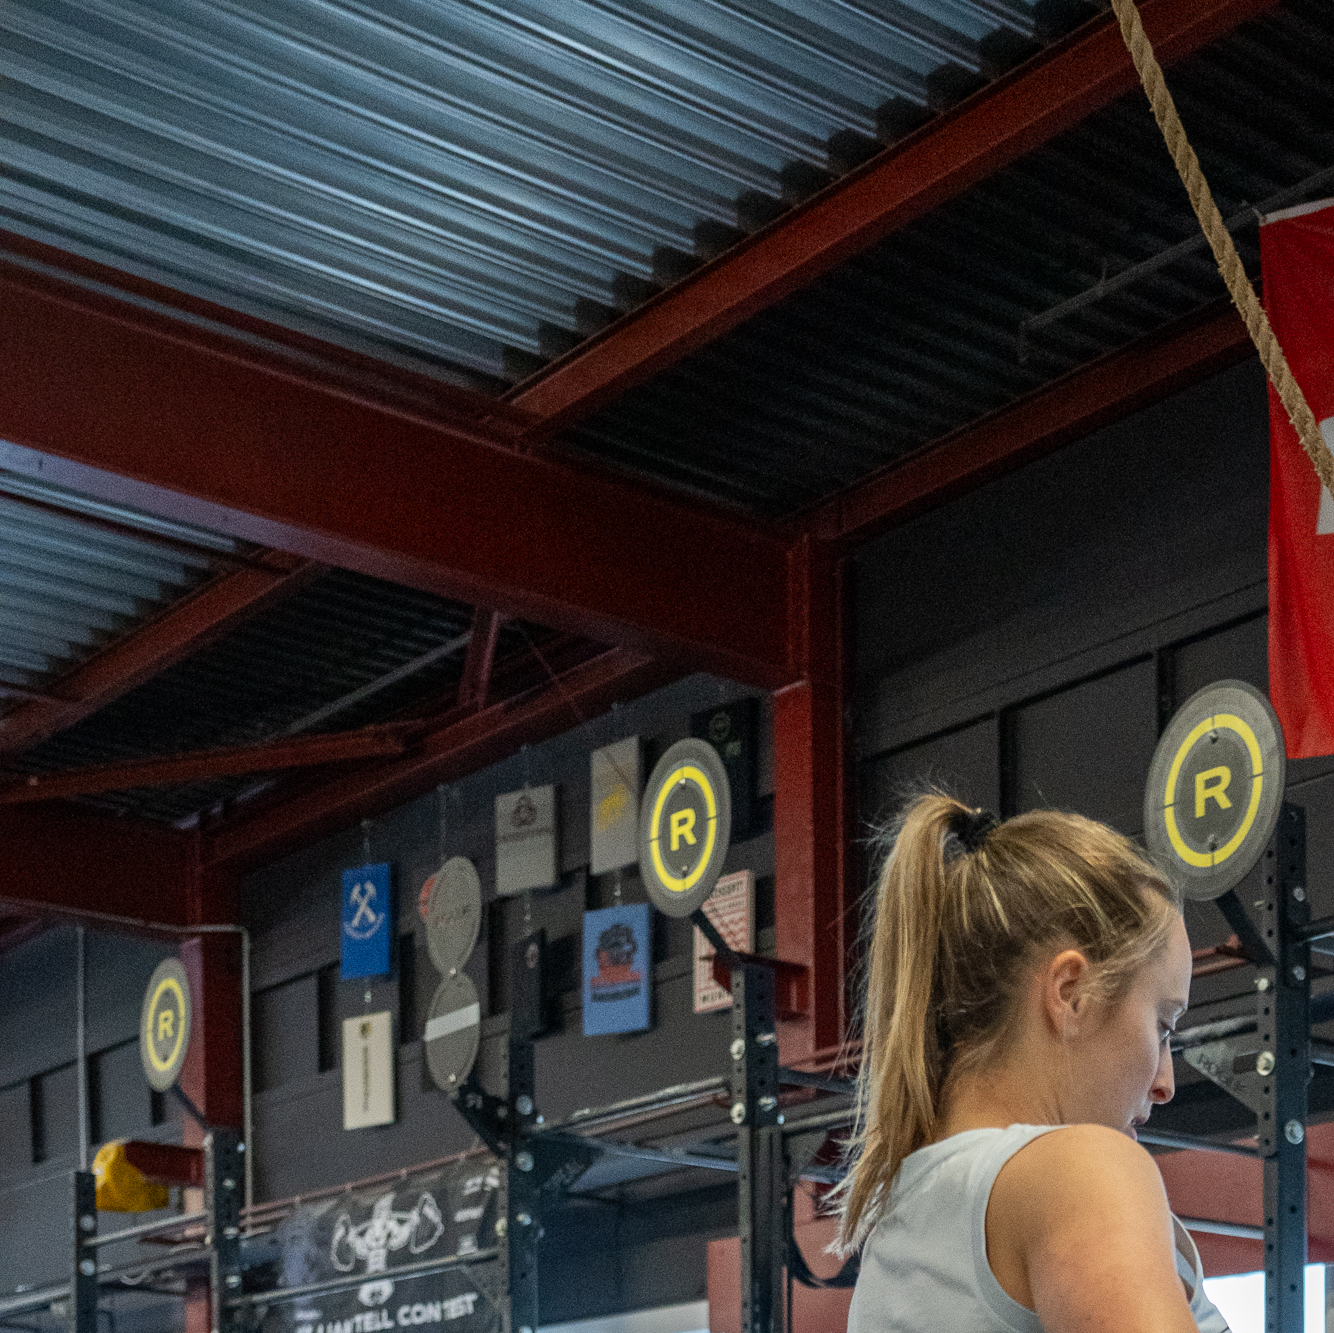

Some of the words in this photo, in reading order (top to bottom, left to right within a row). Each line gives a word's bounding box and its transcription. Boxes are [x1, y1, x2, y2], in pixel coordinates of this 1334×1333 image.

[1194, 764, 1232, 818] R
[670, 808, 697, 851] R
[158, 1009, 174, 1041] R
